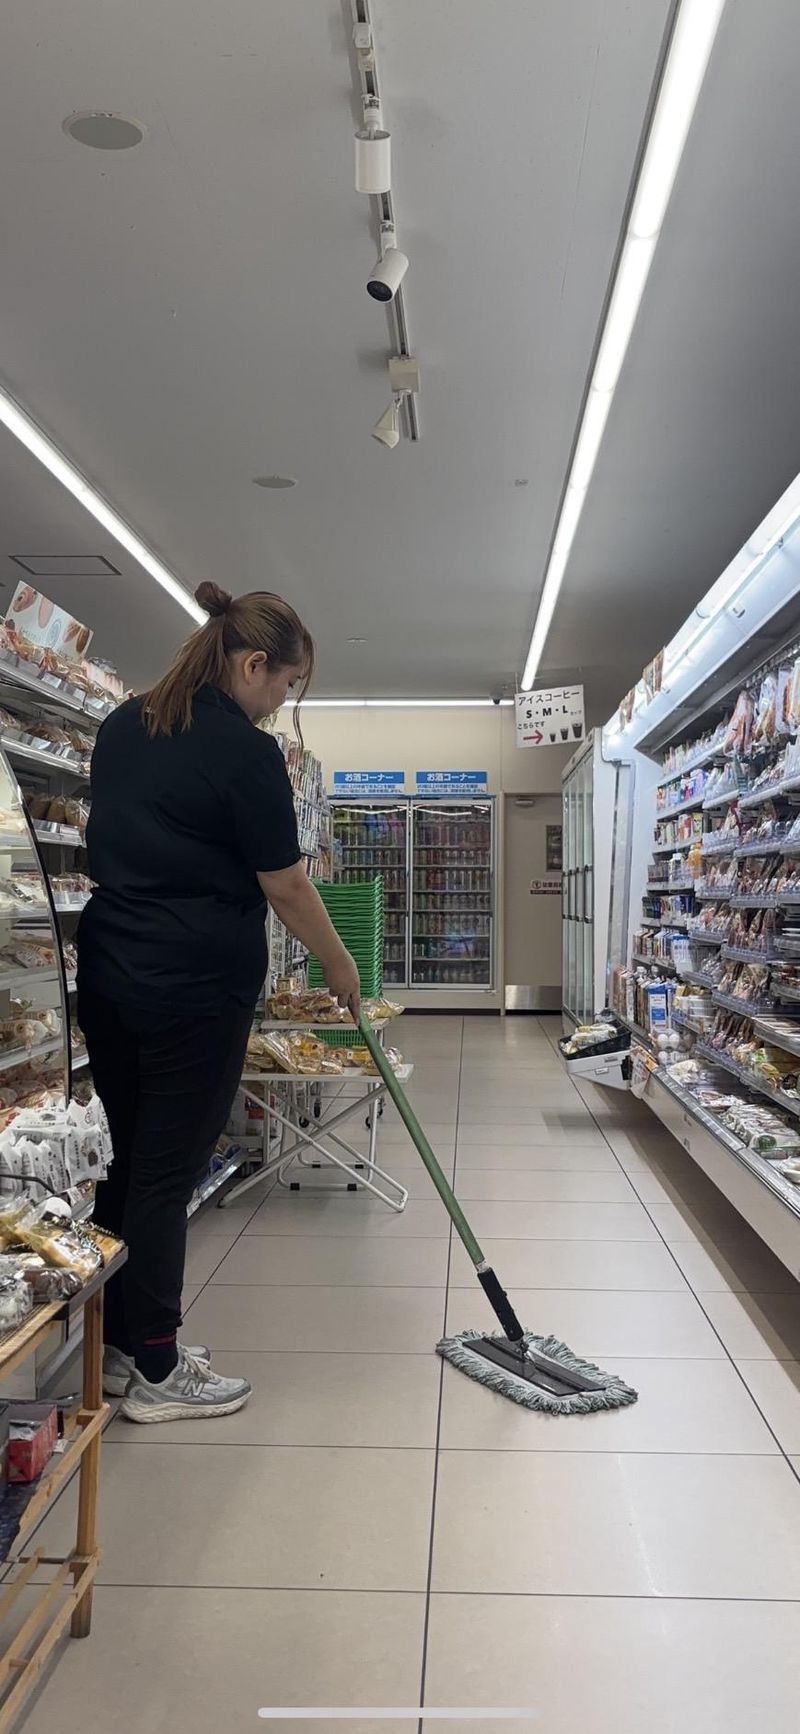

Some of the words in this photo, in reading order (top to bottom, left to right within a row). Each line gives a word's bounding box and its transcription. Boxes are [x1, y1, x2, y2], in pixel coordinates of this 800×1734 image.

[518, 691, 580, 706] アイスコーヒー
[517, 721, 545, 730] こちらです
[345, 773, 394, 782] お酒コーナー
[427, 773, 476, 782] お酒コーナー
